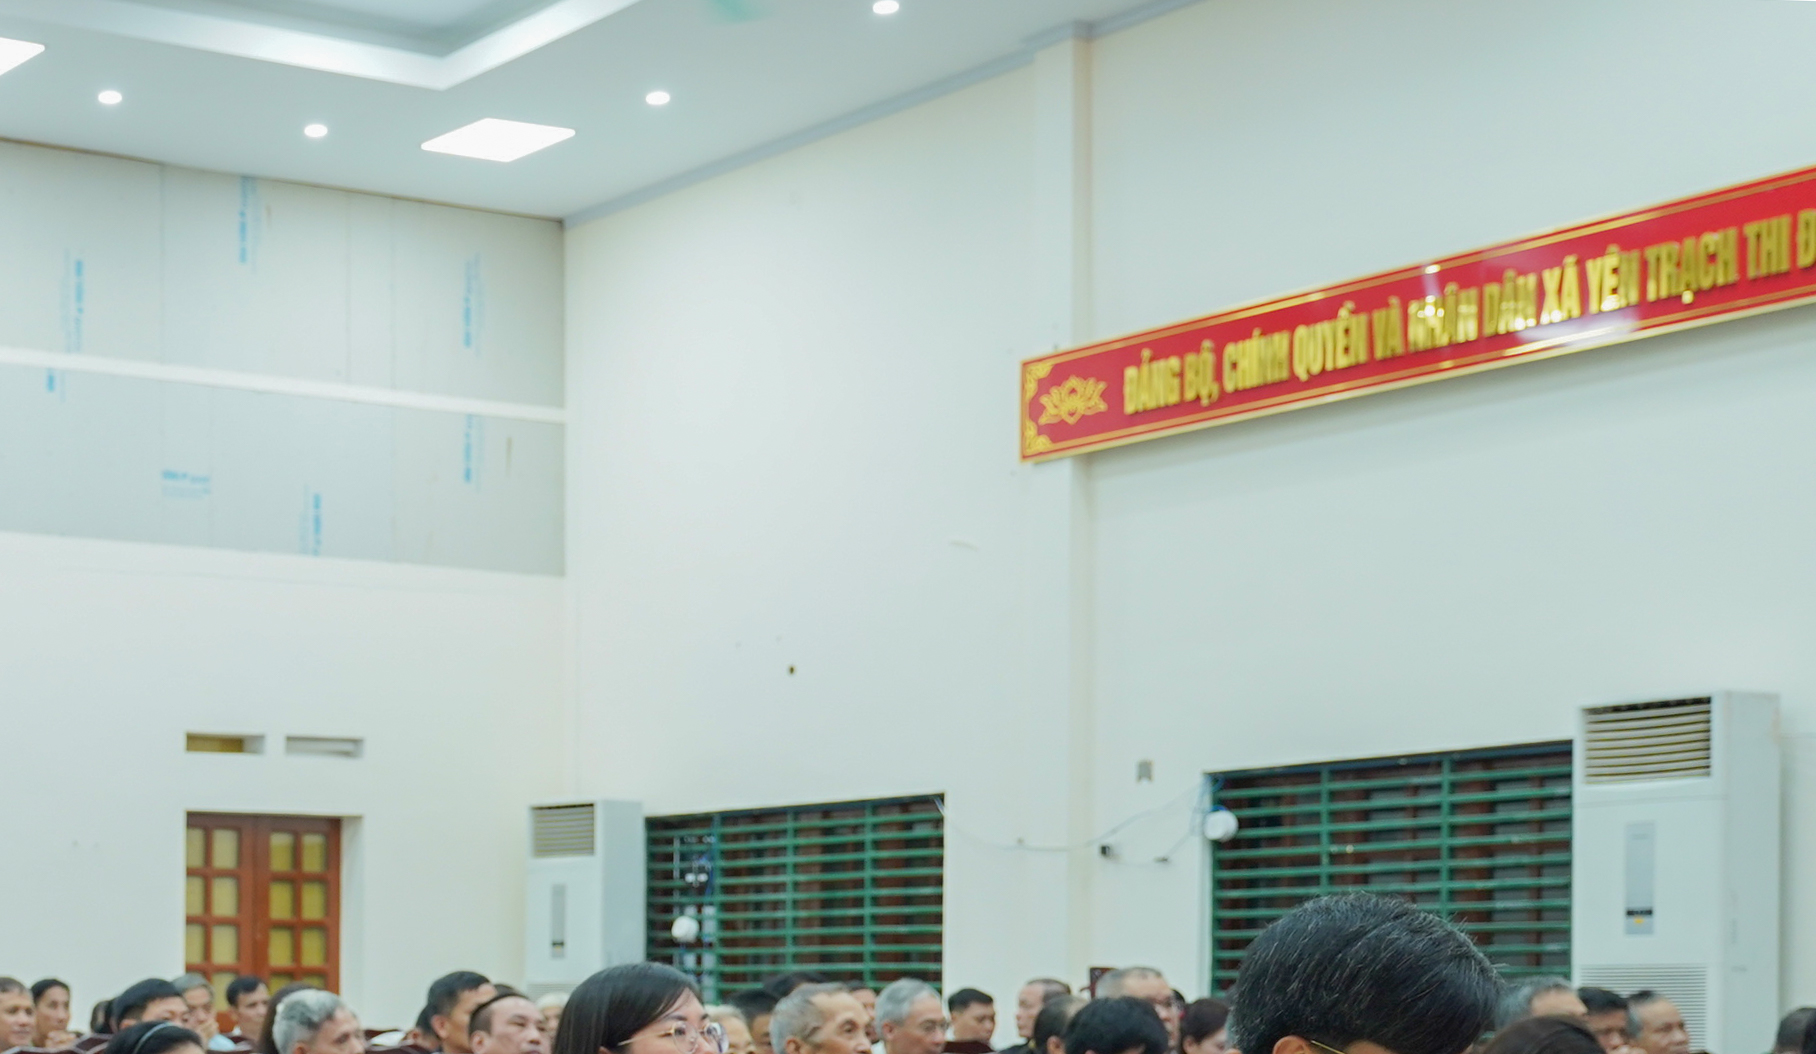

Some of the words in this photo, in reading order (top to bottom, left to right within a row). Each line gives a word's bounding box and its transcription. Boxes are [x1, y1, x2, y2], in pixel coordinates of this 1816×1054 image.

[1222, 327, 1291, 393] CHÍNH
[1292, 300, 1370, 382] QUYỀN
[1371, 295, 1406, 361] VÀ
[1540, 254, 1582, 325] XÃ
[1585, 243, 1640, 315] YÊN
[1644, 226, 1740, 304] TRẠCH
[1743, 213, 1792, 280] THI
